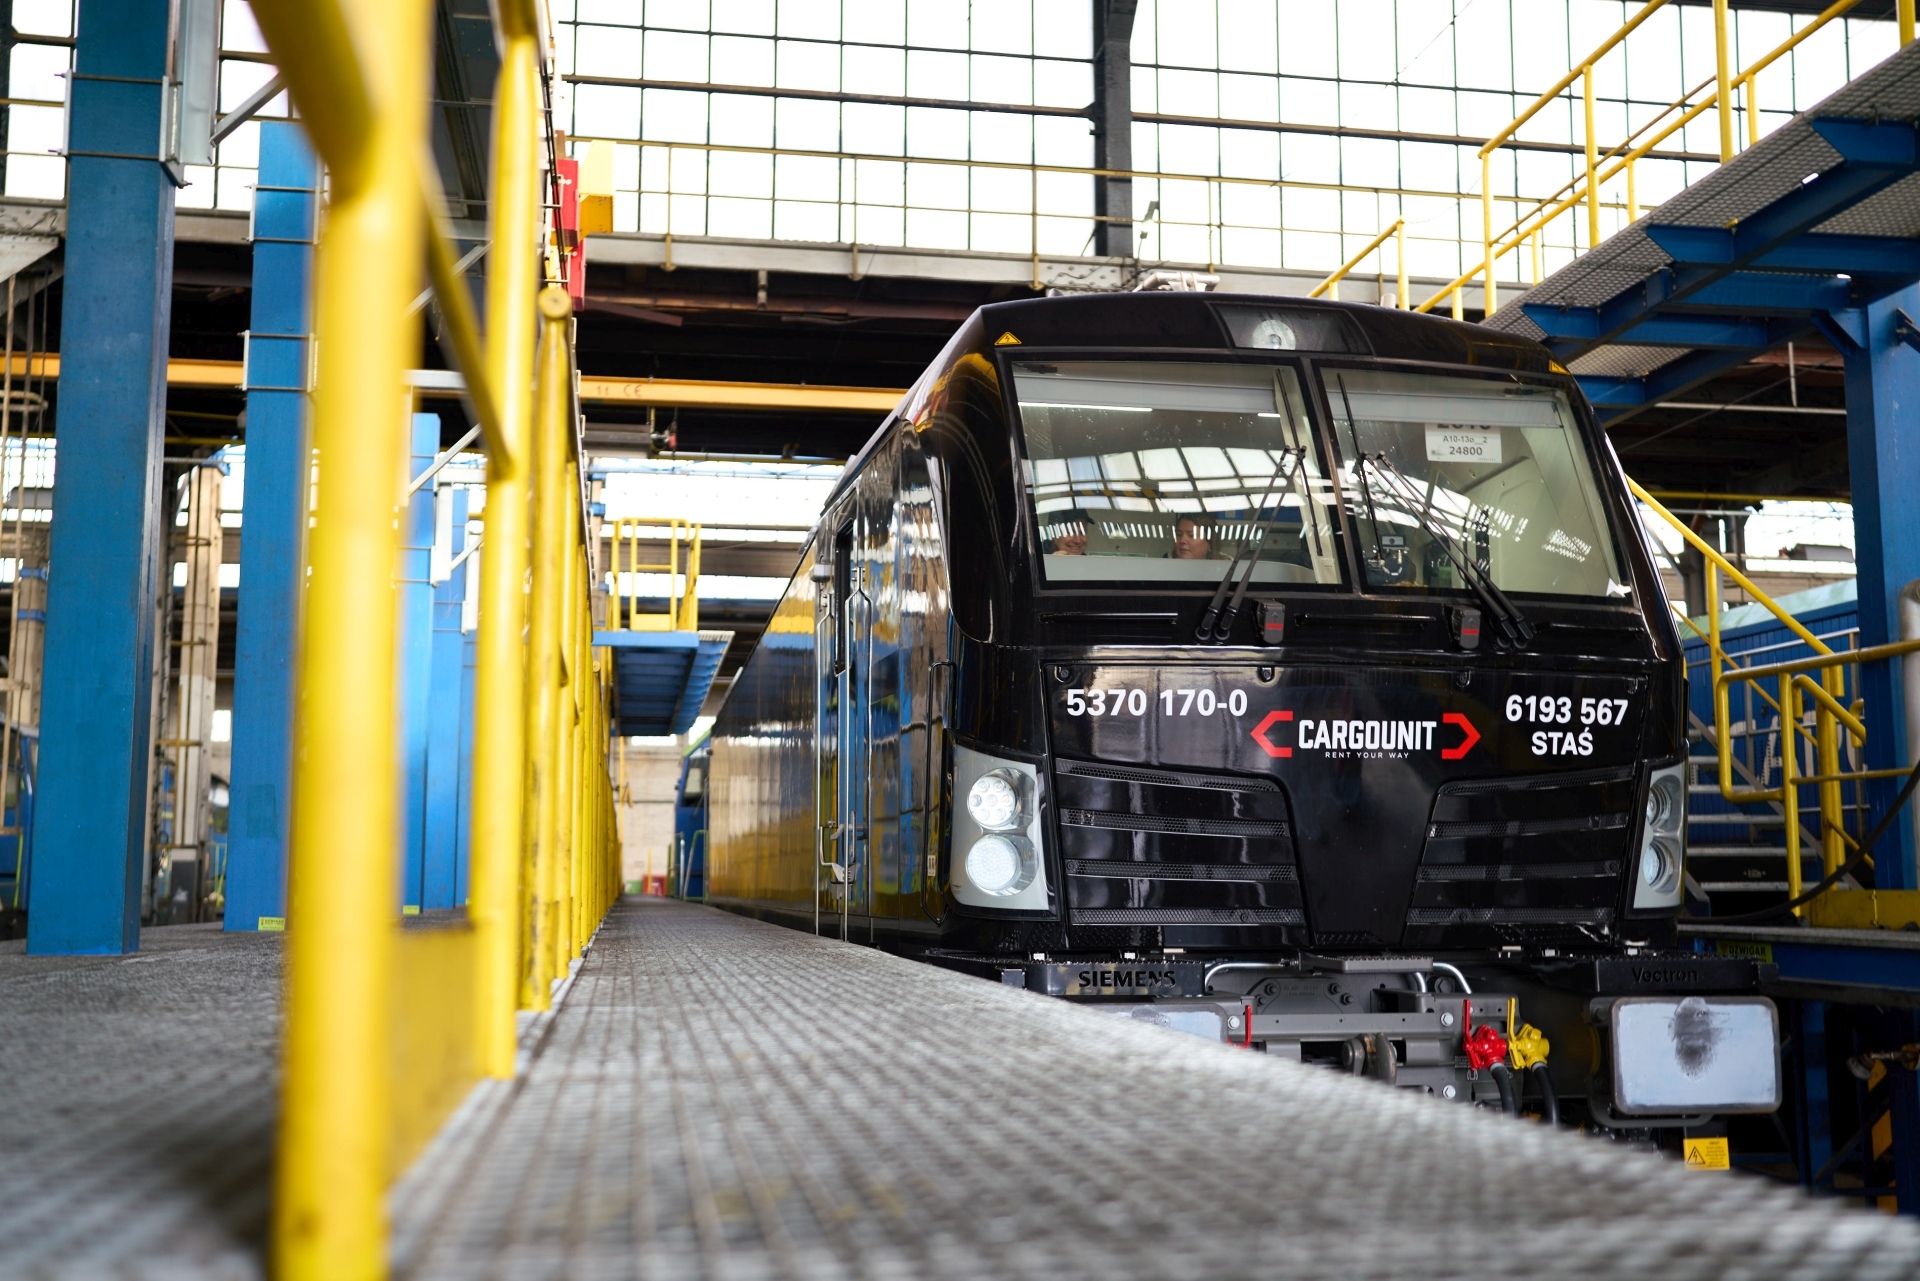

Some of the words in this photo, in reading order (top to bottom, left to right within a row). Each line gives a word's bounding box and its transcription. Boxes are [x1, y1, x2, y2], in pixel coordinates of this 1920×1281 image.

[1449, 446, 1483, 456] 24800
[1066, 688, 1147, 717] 5370
[1159, 688, 1248, 717] 170-0
[1505, 694, 1572, 724] 6193
[1580, 697, 1629, 726] 567
[1298, 719, 1437, 751] CARGOUNIT
[1531, 726, 1594, 757] STAŚ
[1325, 751, 1352, 759] RENT
[1356, 751, 1384, 759] YOUR
[1388, 751, 1409, 760] WAY
[1078, 970, 1176, 988] SIEMENS
[1631, 967, 1699, 983] Vectron
